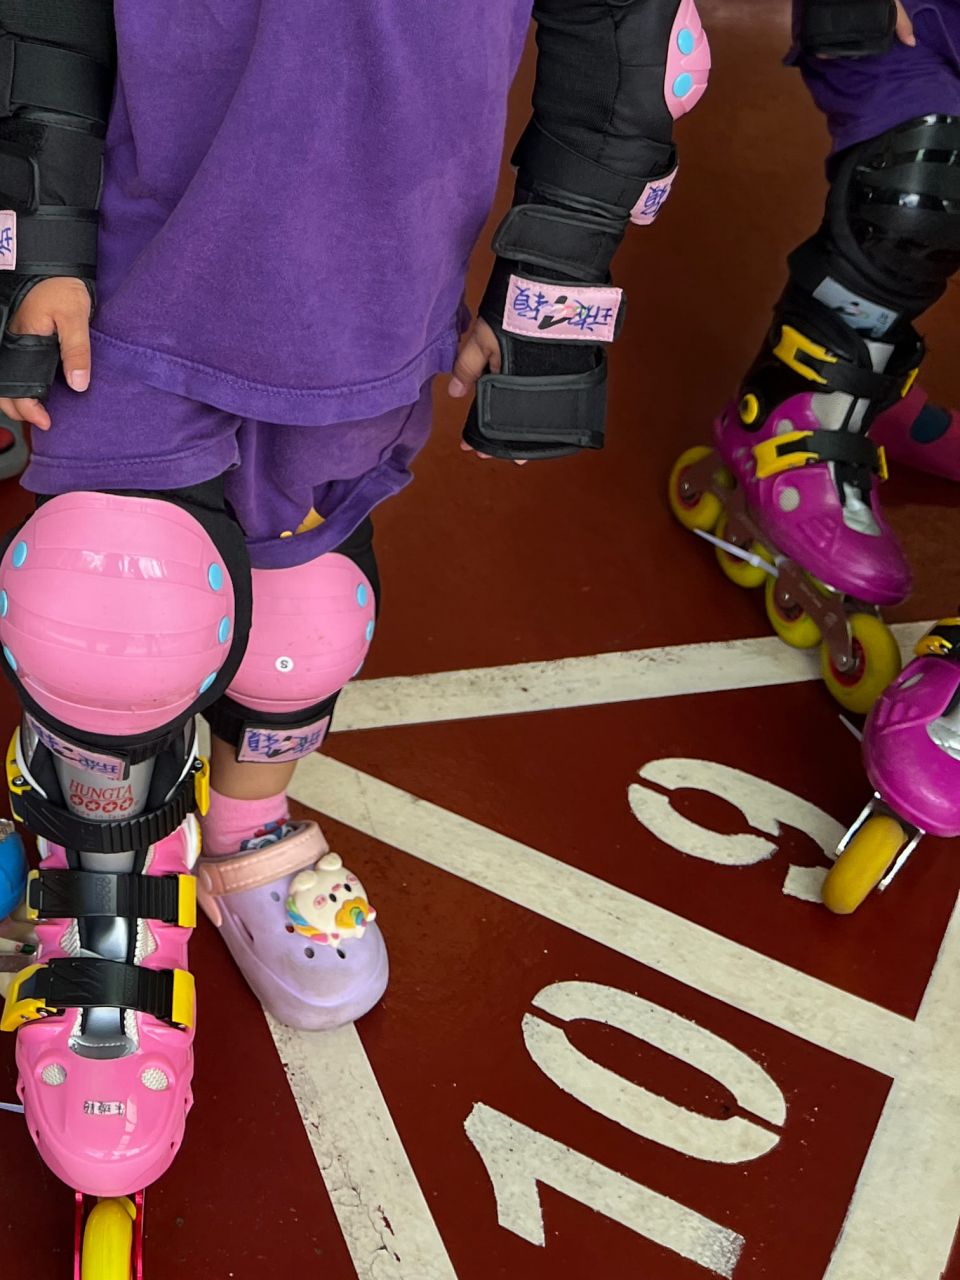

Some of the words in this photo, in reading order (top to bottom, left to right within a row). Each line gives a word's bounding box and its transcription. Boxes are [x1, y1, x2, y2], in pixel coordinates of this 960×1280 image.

[69, 779, 133, 800] HUNGTA
[627, 757, 848, 903] 9
[464, 981, 786, 1280] 10
